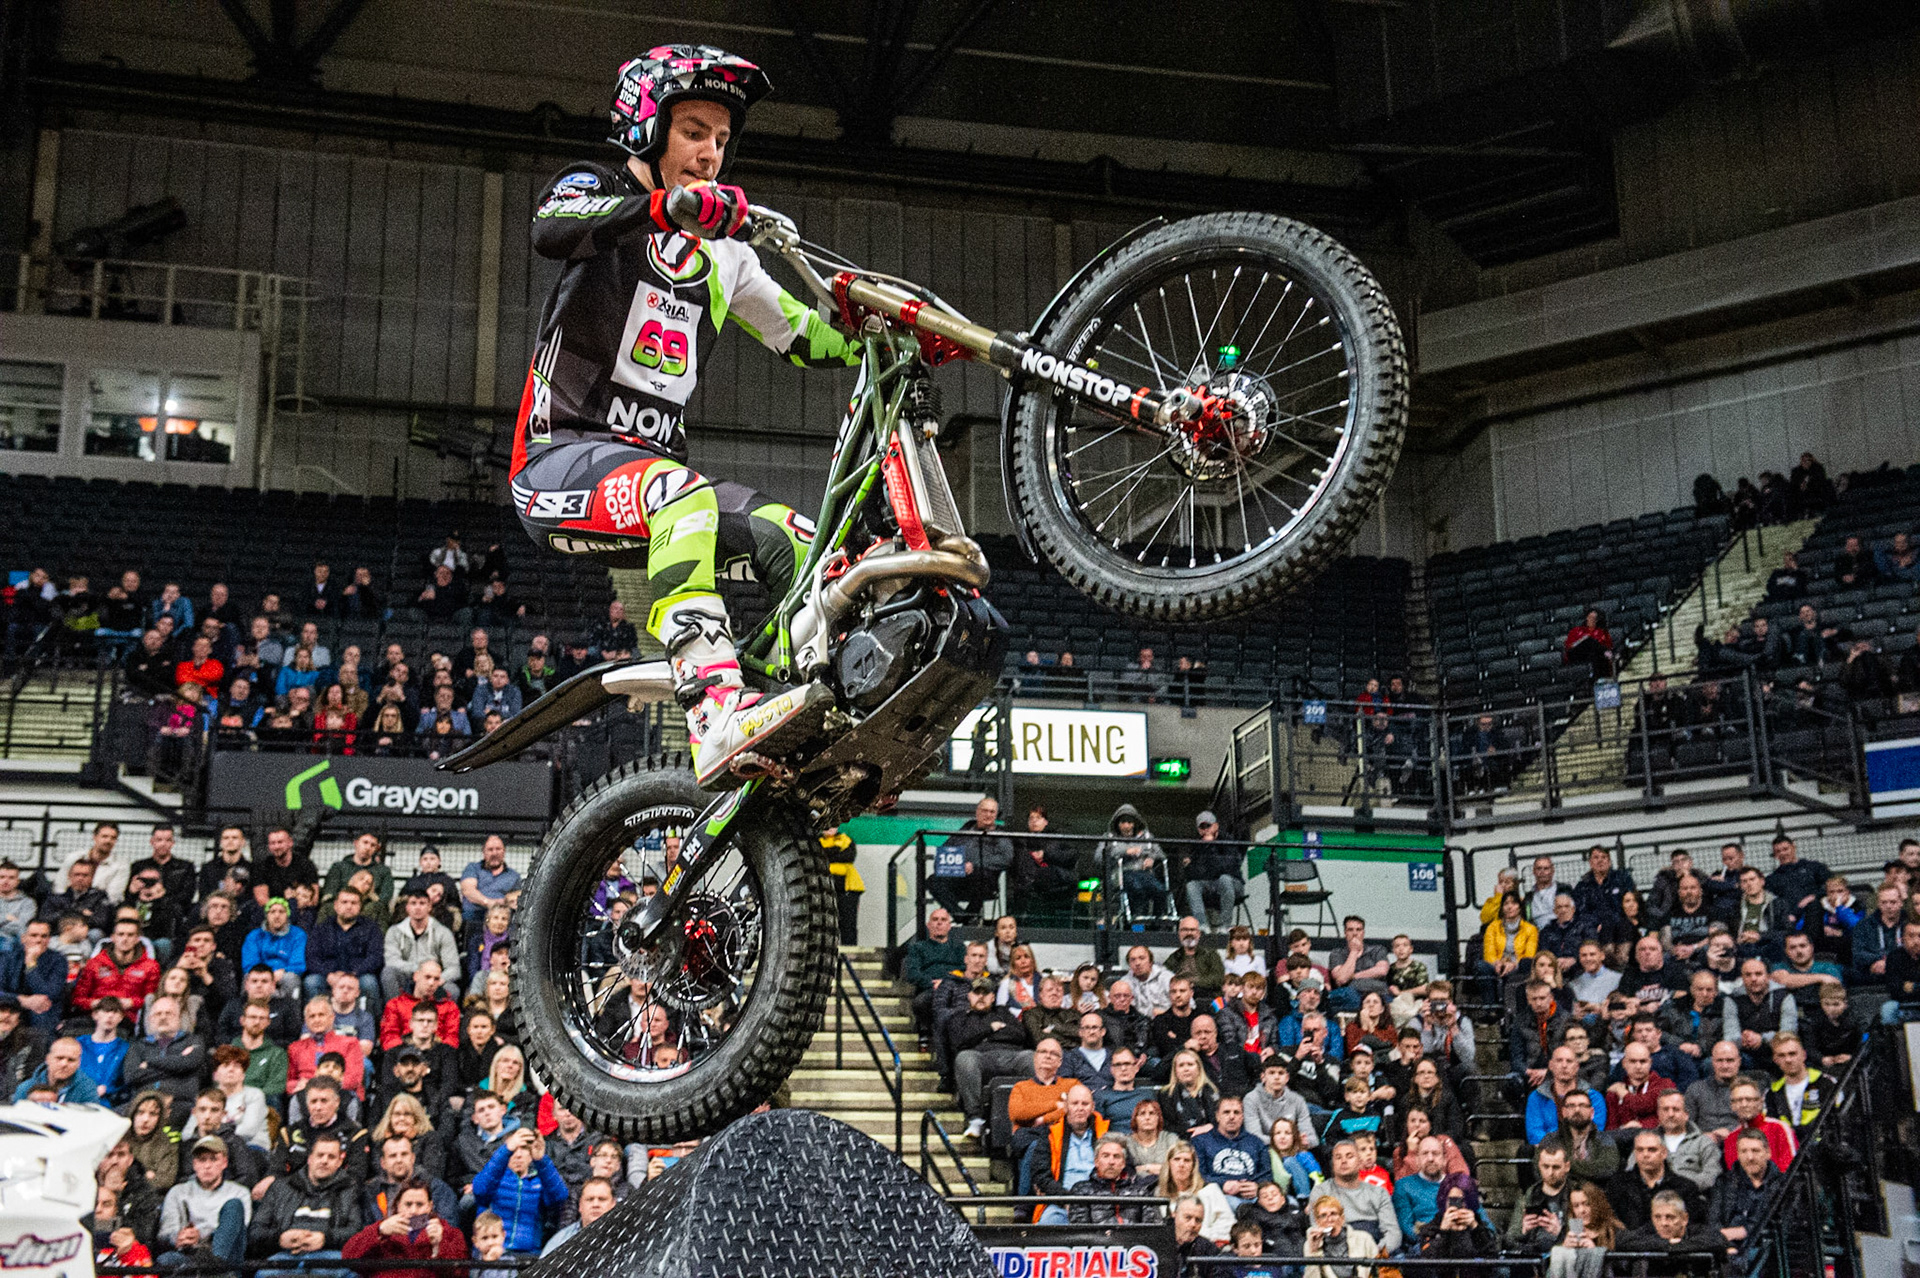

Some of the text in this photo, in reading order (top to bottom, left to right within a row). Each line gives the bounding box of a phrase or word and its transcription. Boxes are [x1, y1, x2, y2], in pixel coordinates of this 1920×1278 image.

[619, 88, 637, 107] STOP
[623, 76, 641, 97] NON
[704, 78, 728, 92] NON
[630, 319, 689, 378] 69
[1021, 347, 1132, 407] NONSTOP
[606, 395, 677, 444] NON
[604, 476, 627, 531] NON
[615, 473, 637, 528] STOP
[740, 695, 793, 737] BUSTO
[975, 720, 1126, 765] RLING
[346, 777, 479, 813] Grayson
[939, 853, 964, 865] 108
[1411, 868, 1435, 880] 108
